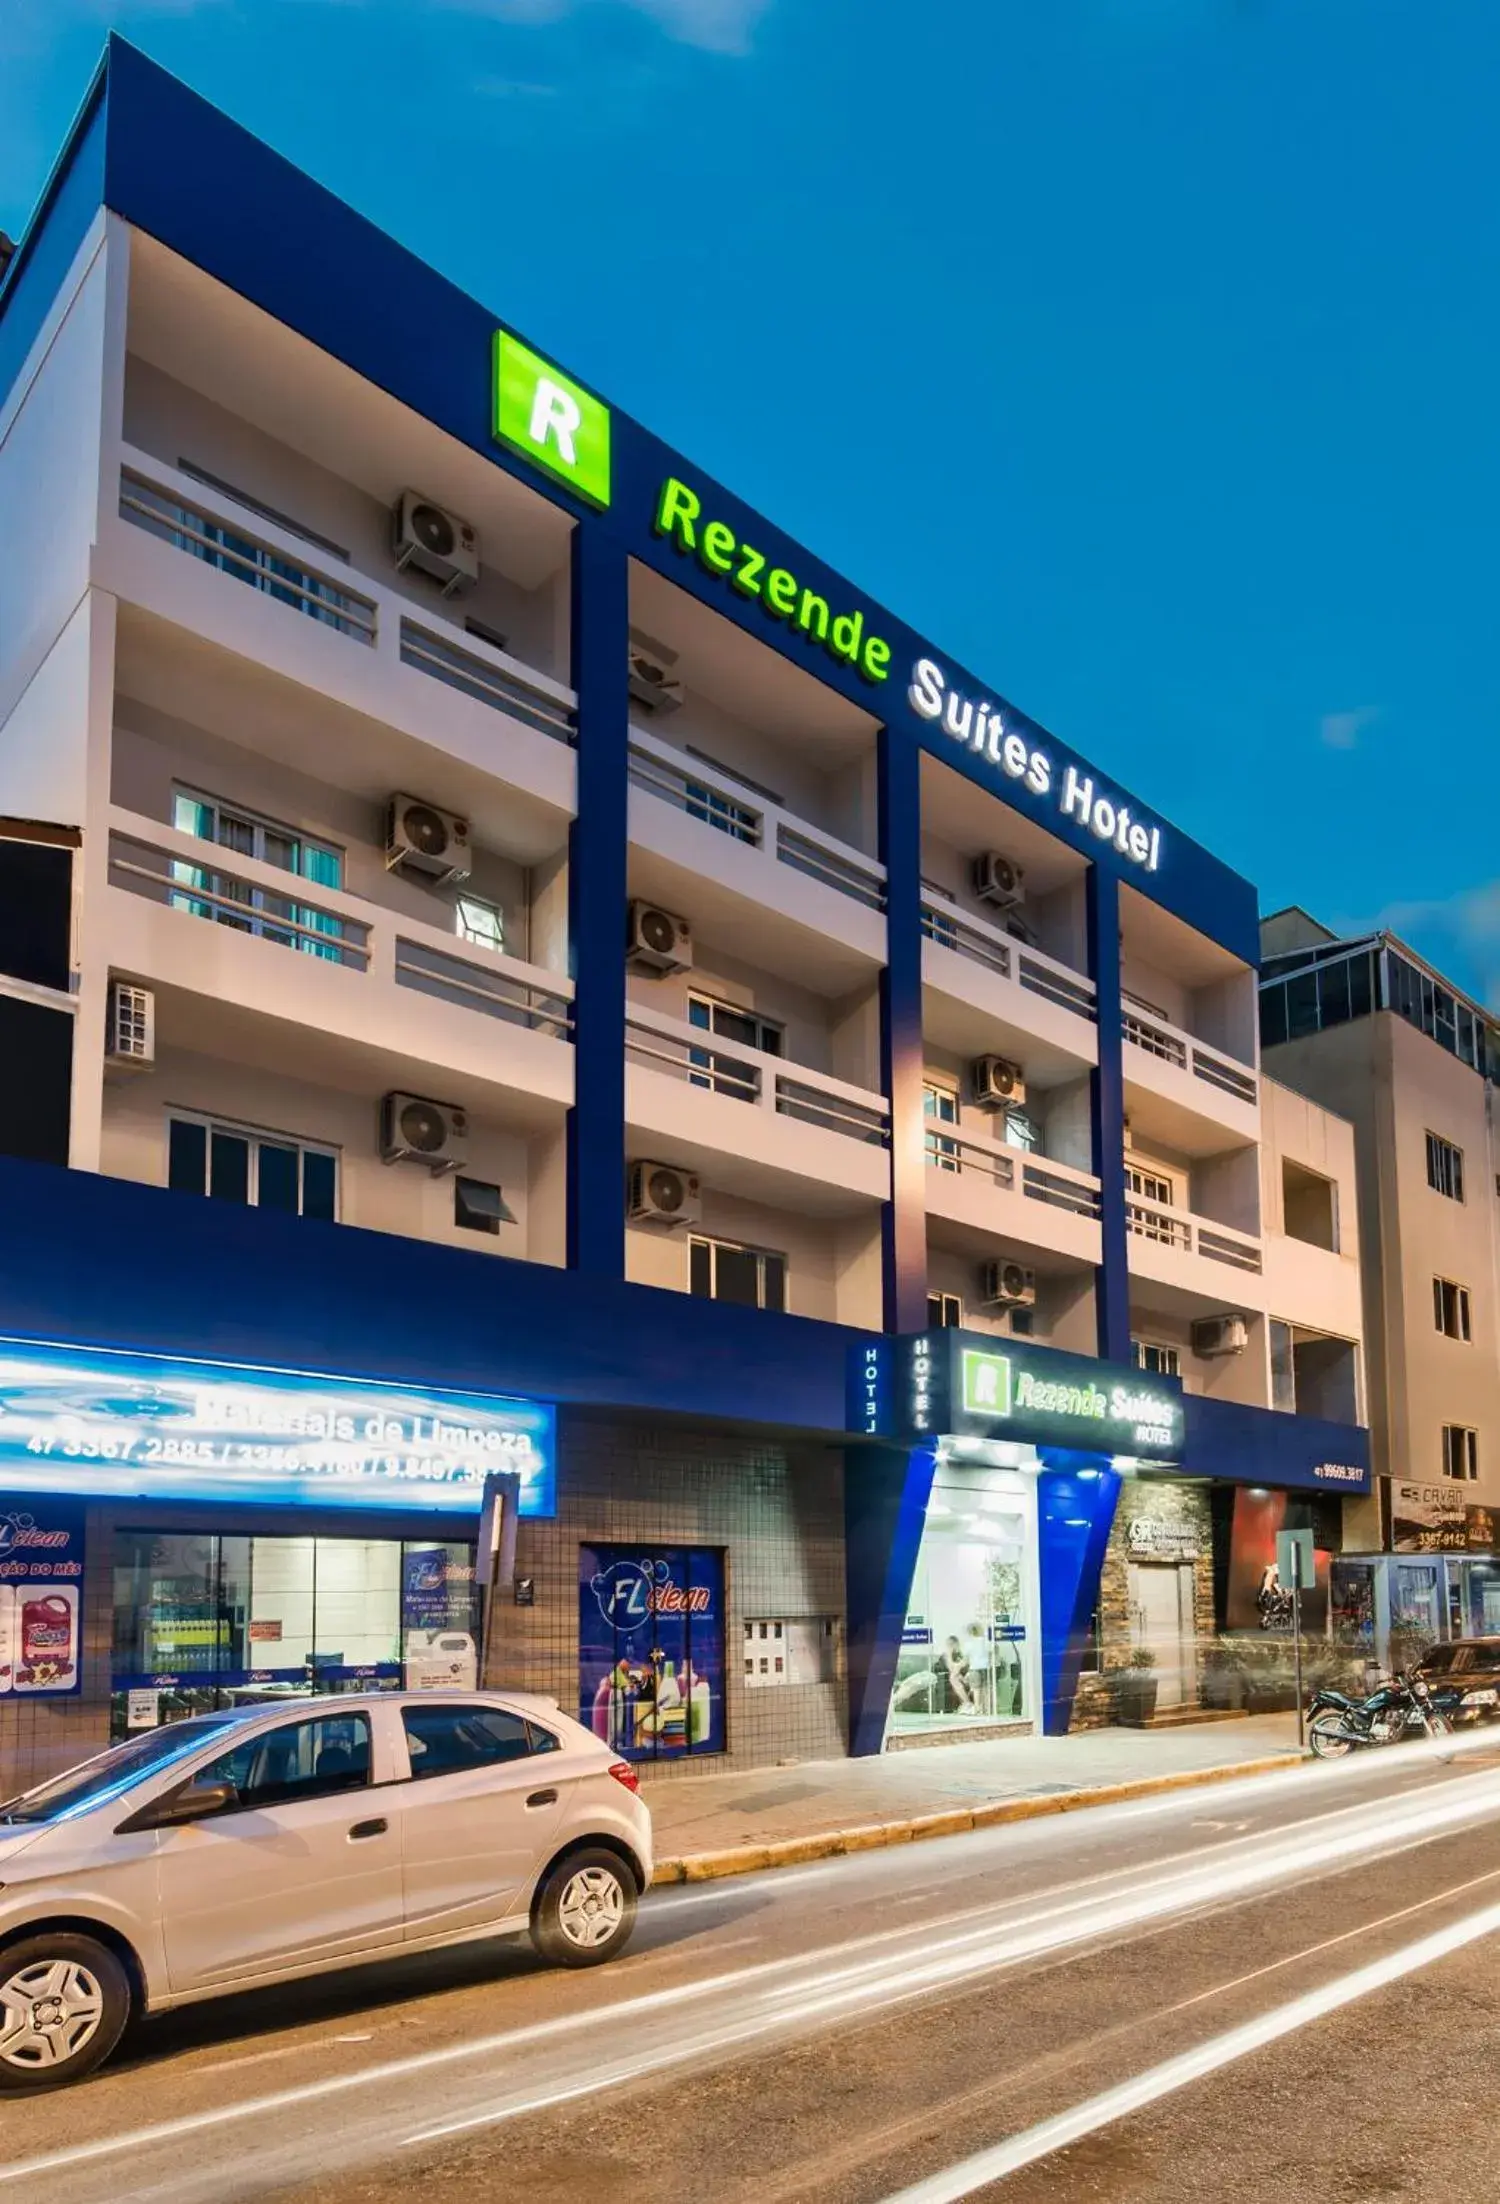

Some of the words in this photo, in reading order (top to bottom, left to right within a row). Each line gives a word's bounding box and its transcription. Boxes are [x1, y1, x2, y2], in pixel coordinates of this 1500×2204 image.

[528, 376, 581, 467] R
[656, 477, 892, 681] Rezende
[1060, 766, 1161, 872] Hotel
[913, 1338, 929, 1430] HOTEL
[1014, 1371, 1108, 1419] Rezende
[364, 1411, 404, 1443] de
[1136, 1426, 1173, 1446] HOTEL
[30, 1562, 52, 1576] DO
[53, 1560, 81, 1576] MÊS
[607, 1578, 645, 1615] FL
[646, 1580, 710, 1613] clean
